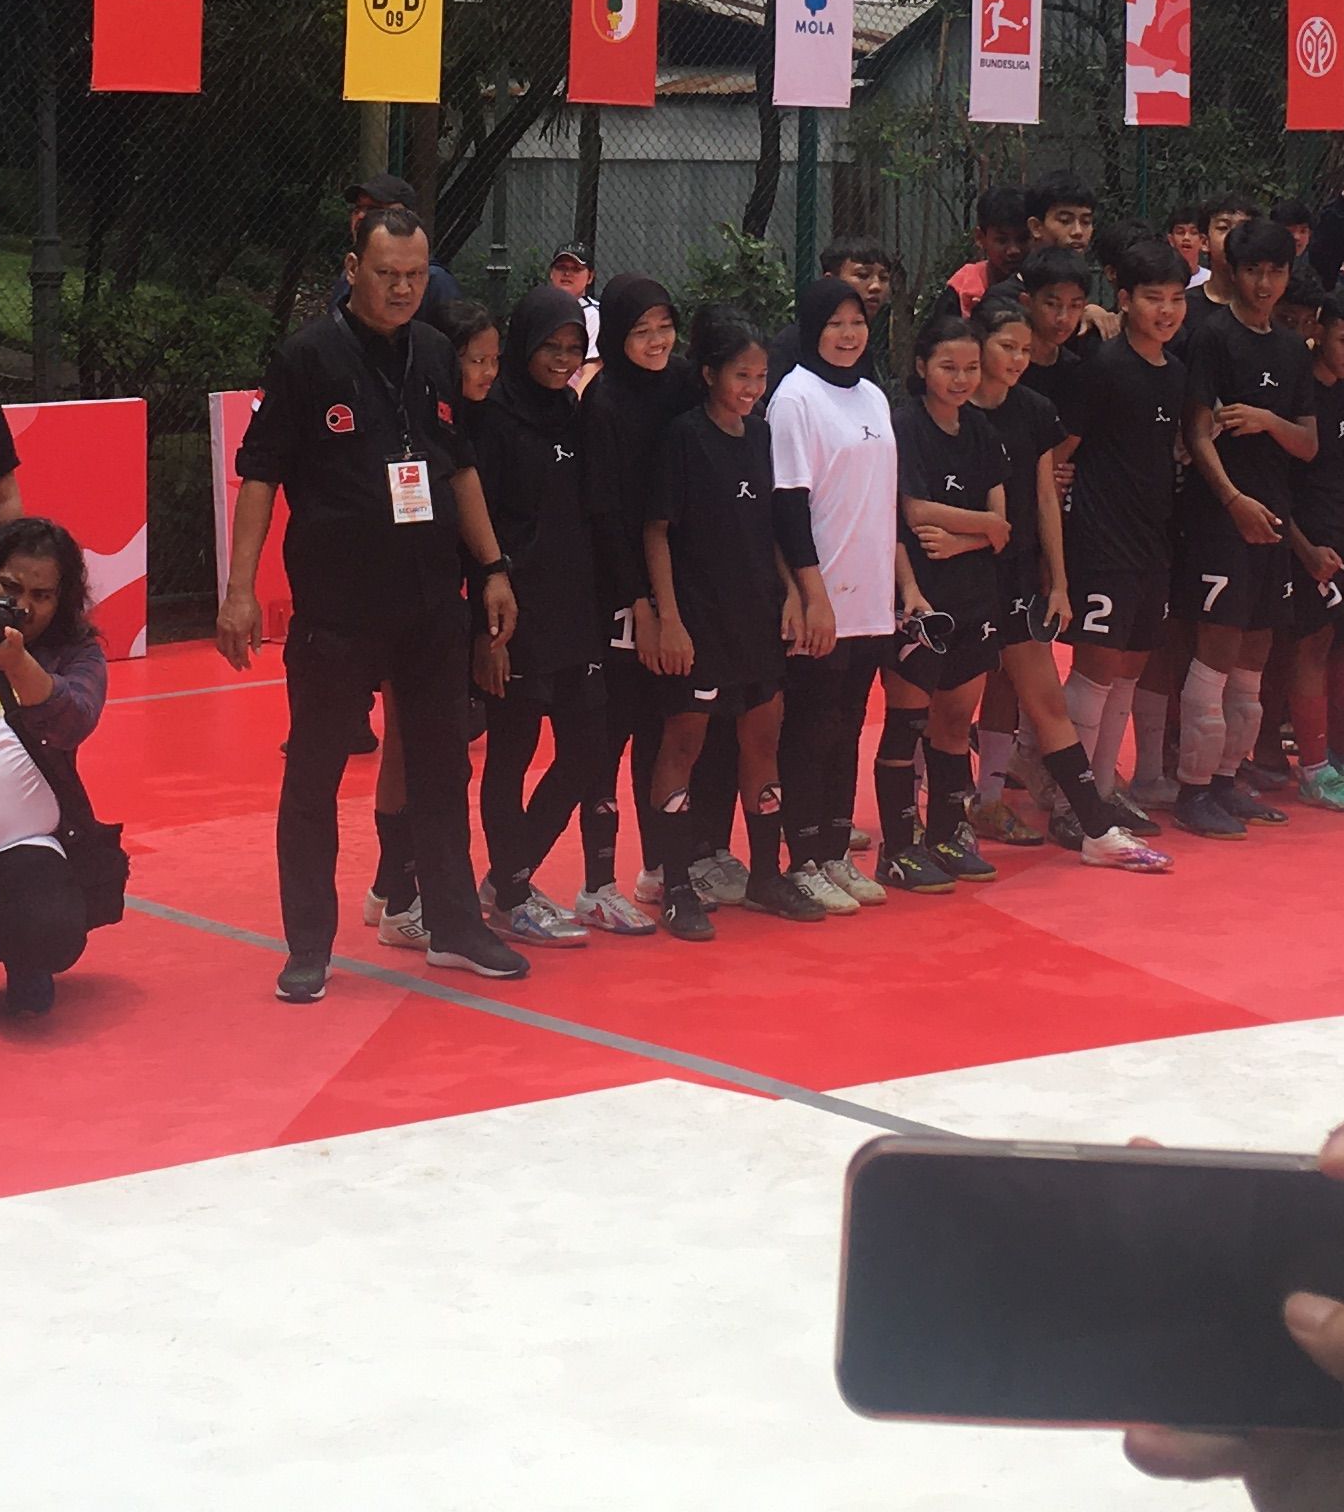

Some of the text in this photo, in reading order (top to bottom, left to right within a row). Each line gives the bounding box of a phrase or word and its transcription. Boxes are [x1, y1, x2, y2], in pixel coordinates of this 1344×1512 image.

[386, 10, 403, 27] 09
[795, 20, 835, 35] MOLA
[980, 58, 1031, 71] BUNDESLIGA
[1201, 574, 1229, 612] 7
[1082, 593, 1113, 633] 2
[610, 607, 636, 649] 1
